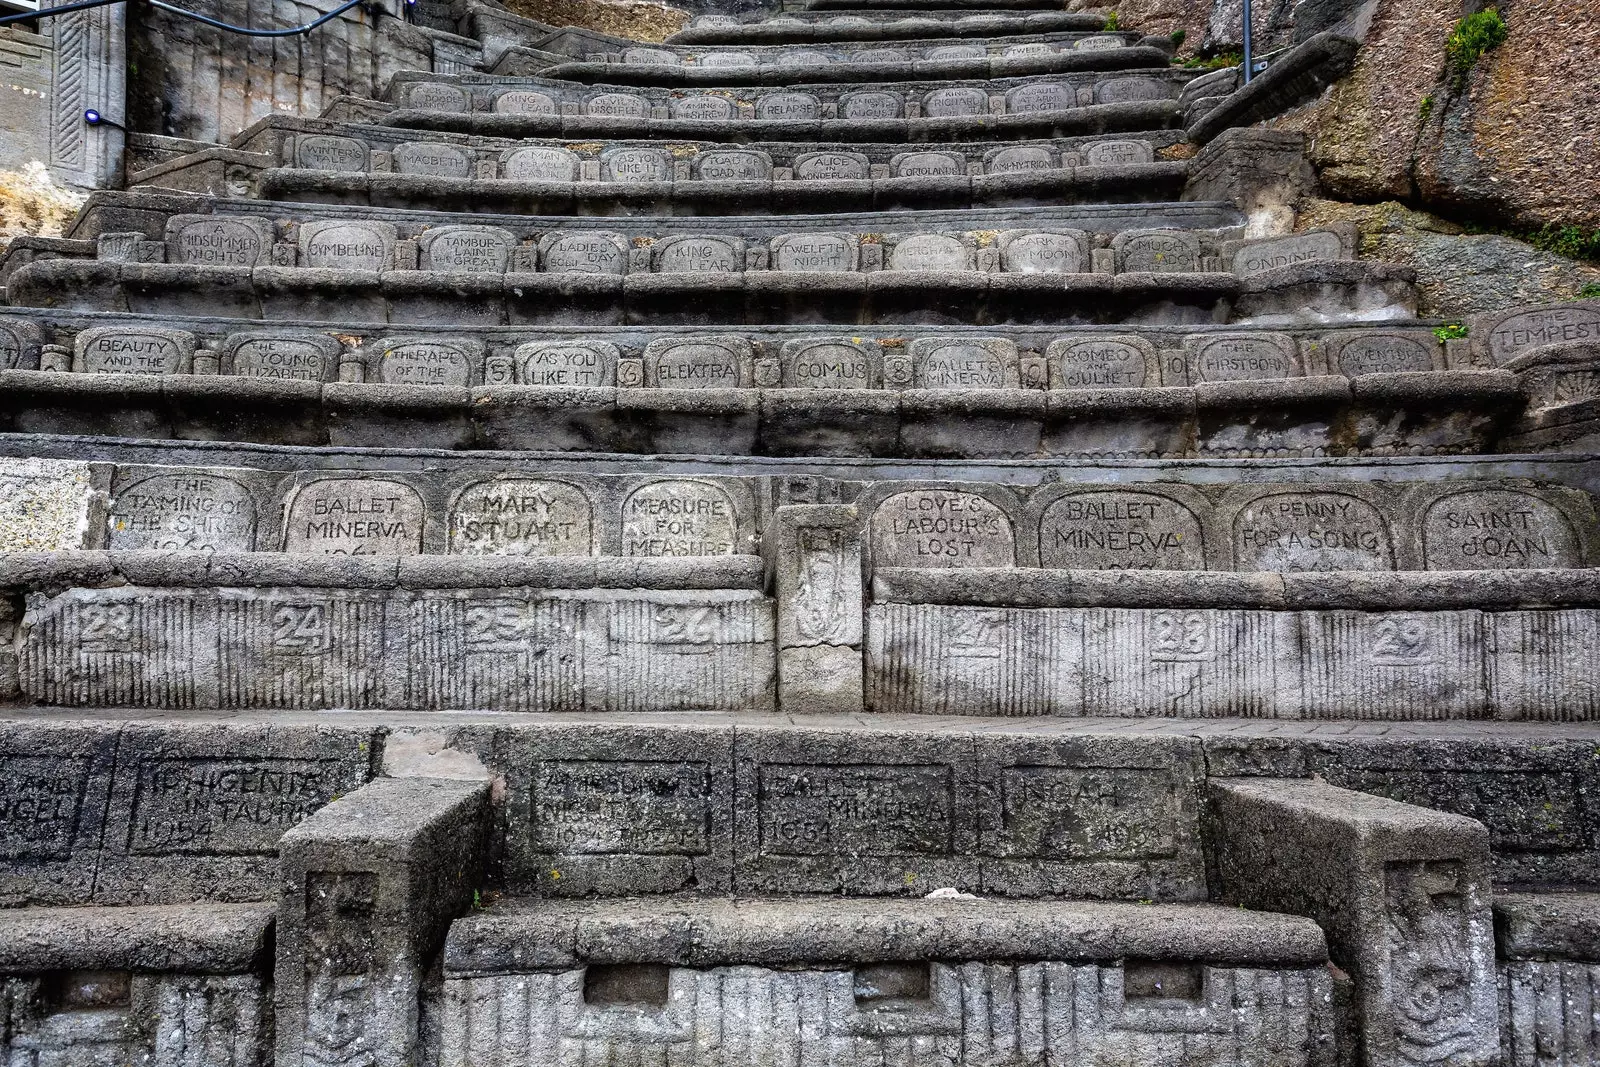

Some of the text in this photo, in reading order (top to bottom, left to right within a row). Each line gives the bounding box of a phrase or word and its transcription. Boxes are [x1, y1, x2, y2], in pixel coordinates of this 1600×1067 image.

[506, 94, 536, 103] KING
[934, 98, 980, 107] RICHARD
[522, 104, 550, 112] LEAR
[767, 104, 813, 114] RELAPSE
[306, 144, 362, 159] WINTER'S
[530, 151, 560, 160] MAN
[1102, 144, 1134, 154] PEER
[314, 154, 346, 164] TALE
[374, 152, 388, 172] 2
[404, 155, 464, 168] MACBETH
[616, 153, 660, 164] AS YOU
[708, 156, 741, 166] TOAD
[814, 157, 850, 166] ALICE
[1099, 153, 1136, 164] GYNT
[512, 170, 566, 179] SEASONS
[616, 164, 659, 173] LIKE IT
[702, 167, 766, 178] TOAD HALL
[800, 170, 862, 180] WONDERLAND
[899, 166, 959, 178] CORIOLANUS
[214, 224, 226, 235] A
[179, 233, 258, 252] MIDSUMMER
[444, 237, 503, 247] TAMBUR-
[560, 242, 612, 253] LADIES'
[1016, 237, 1054, 246] DARK
[1138, 240, 1184, 252] MUCH
[144, 244, 158, 262] 2
[188, 250, 247, 264] NIGHTS
[310, 243, 384, 258] CYMBELINE
[454, 248, 496, 257] LAINE
[676, 246, 713, 258] KING
[782, 244, 846, 255] TWELFTH
[1030, 250, 1074, 260] MOON
[454, 257, 500, 266] GREAT
[588, 252, 617, 263] DAY
[752, 252, 762, 269] 7
[794, 256, 840, 267] NIGHT
[984, 252, 995, 273] 9
[1158, 254, 1189, 266] ADO
[1247, 249, 1318, 271] ONDINE
[689, 259, 730, 272] LEAR
[1526, 311, 1568, 324] THE
[1495, 320, 1600, 347] TEMPEST
[98, 338, 168, 354] BEAUTY
[252, 342, 276, 352] THE
[1221, 343, 1255, 353] THE
[104, 355, 166, 368] AND THE
[259, 352, 319, 368] YOUNG
[394, 350, 459, 365] THE RAPE
[536, 352, 597, 367] AS YOU
[1066, 348, 1130, 363] ROMEO
[395, 365, 446, 378] OF THE
[658, 364, 738, 381] ELEKTRA
[760, 364, 772, 379] 7
[796, 362, 866, 380] COMUS
[892, 360, 907, 382] 8
[928, 358, 1000, 373] BALLETS
[1086, 362, 1110, 372] AND
[1166, 356, 1184, 374] 10
[238, 366, 320, 380] ELIZABETH
[492, 364, 506, 382] 5
[532, 370, 595, 386] LIKE IT
[623, 364, 638, 383] 6
[926, 371, 1000, 386] MINERVA
[1067, 371, 1136, 387] JULIET
[172, 478, 213, 491] THE
[126, 494, 245, 514] TAMING OF
[314, 497, 399, 515] BALLET
[482, 494, 558, 516] MARY
[631, 498, 726, 516] MEASURE
[904, 495, 982, 513] LOVE'S
[1068, 501, 1162, 521] BALLET
[1260, 500, 1353, 518] A PENNY
[112, 512, 162, 532] THE
[655, 518, 694, 536] FOR
[892, 516, 999, 537] LABOUR'S
[1446, 510, 1534, 530] SAINT
[305, 520, 409, 540] MINERVA
[463, 519, 577, 543] STUART
[916, 538, 976, 557] LOST
[1053, 528, 1182, 554] MINERVA
[1241, 530, 1380, 551] FOR A SONG
[1461, 535, 1550, 558] JOAN
[630, 539, 732, 558] MEASURE
[81, 603, 132, 642] 23
[272, 604, 328, 650] 24
